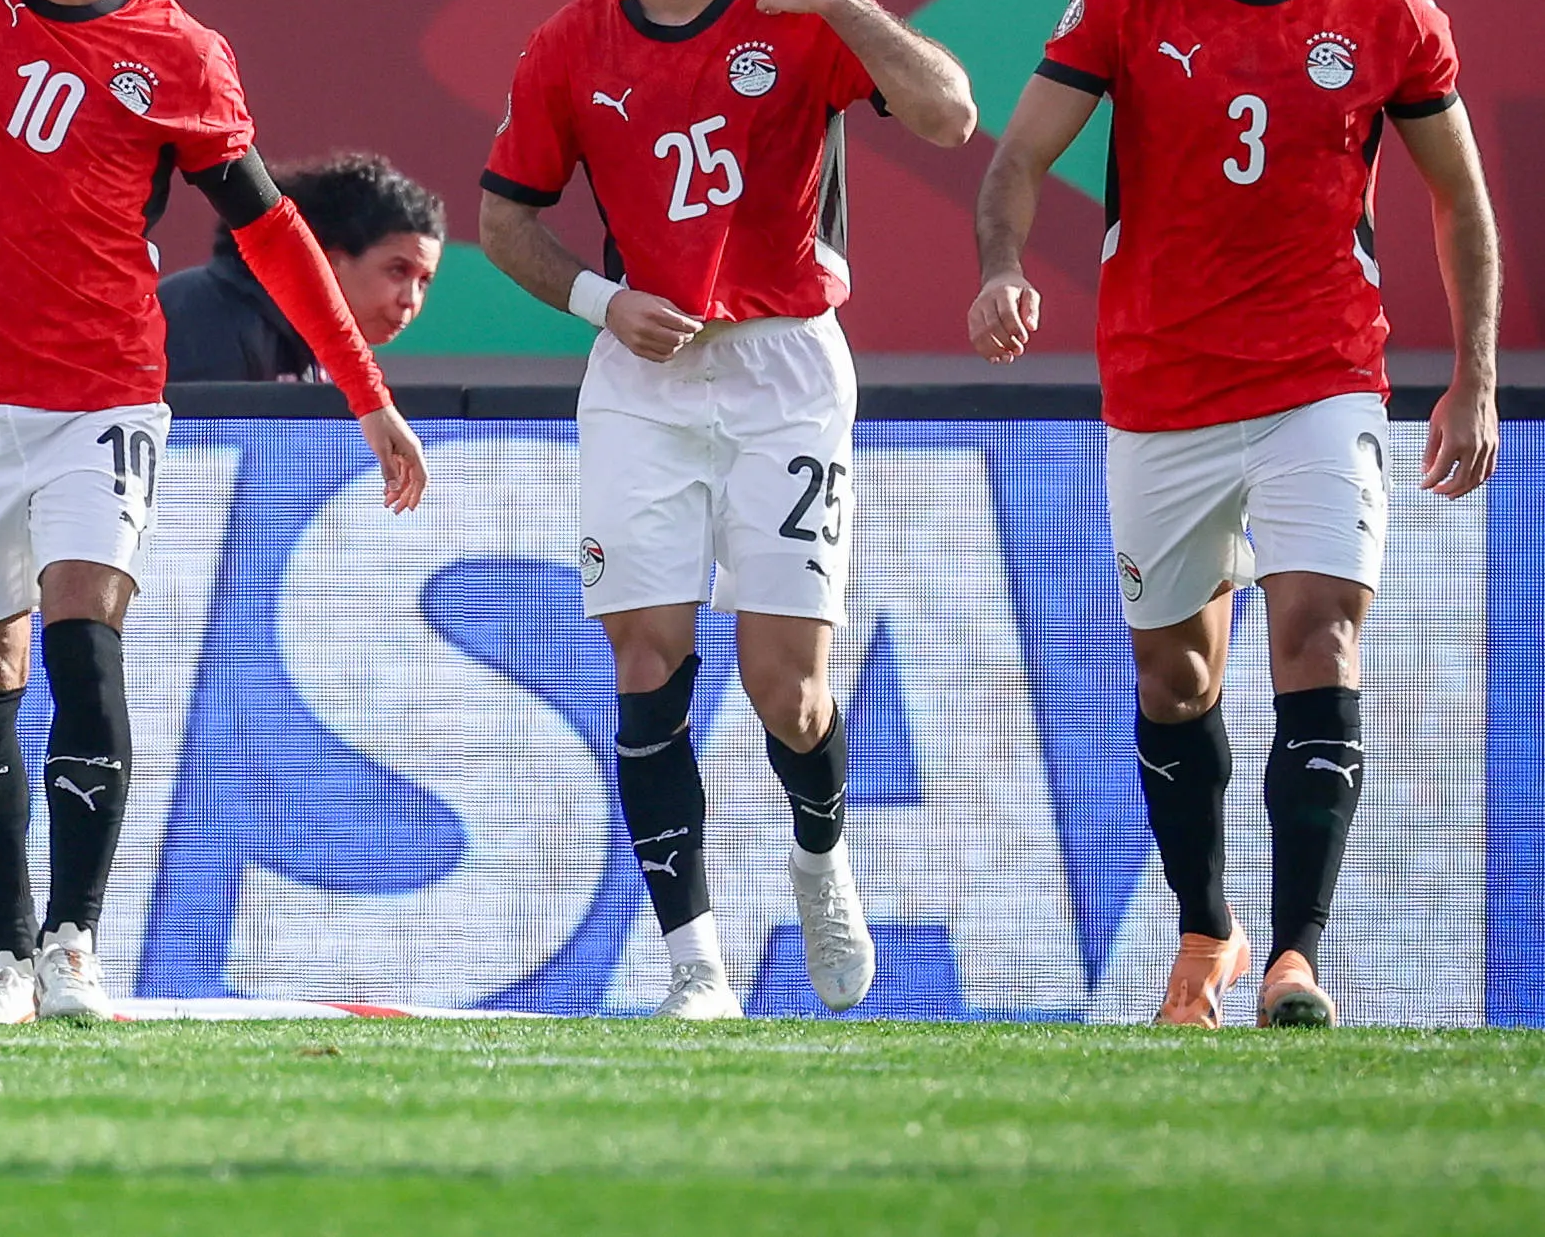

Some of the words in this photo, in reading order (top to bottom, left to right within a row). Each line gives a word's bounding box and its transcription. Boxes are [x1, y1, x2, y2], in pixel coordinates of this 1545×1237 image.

[6, 60, 86, 154] 10
[1222, 94, 1269, 186] 3
[654, 114, 745, 223] 25
[96, 425, 157, 509] 10
[778, 455, 847, 546] 25
